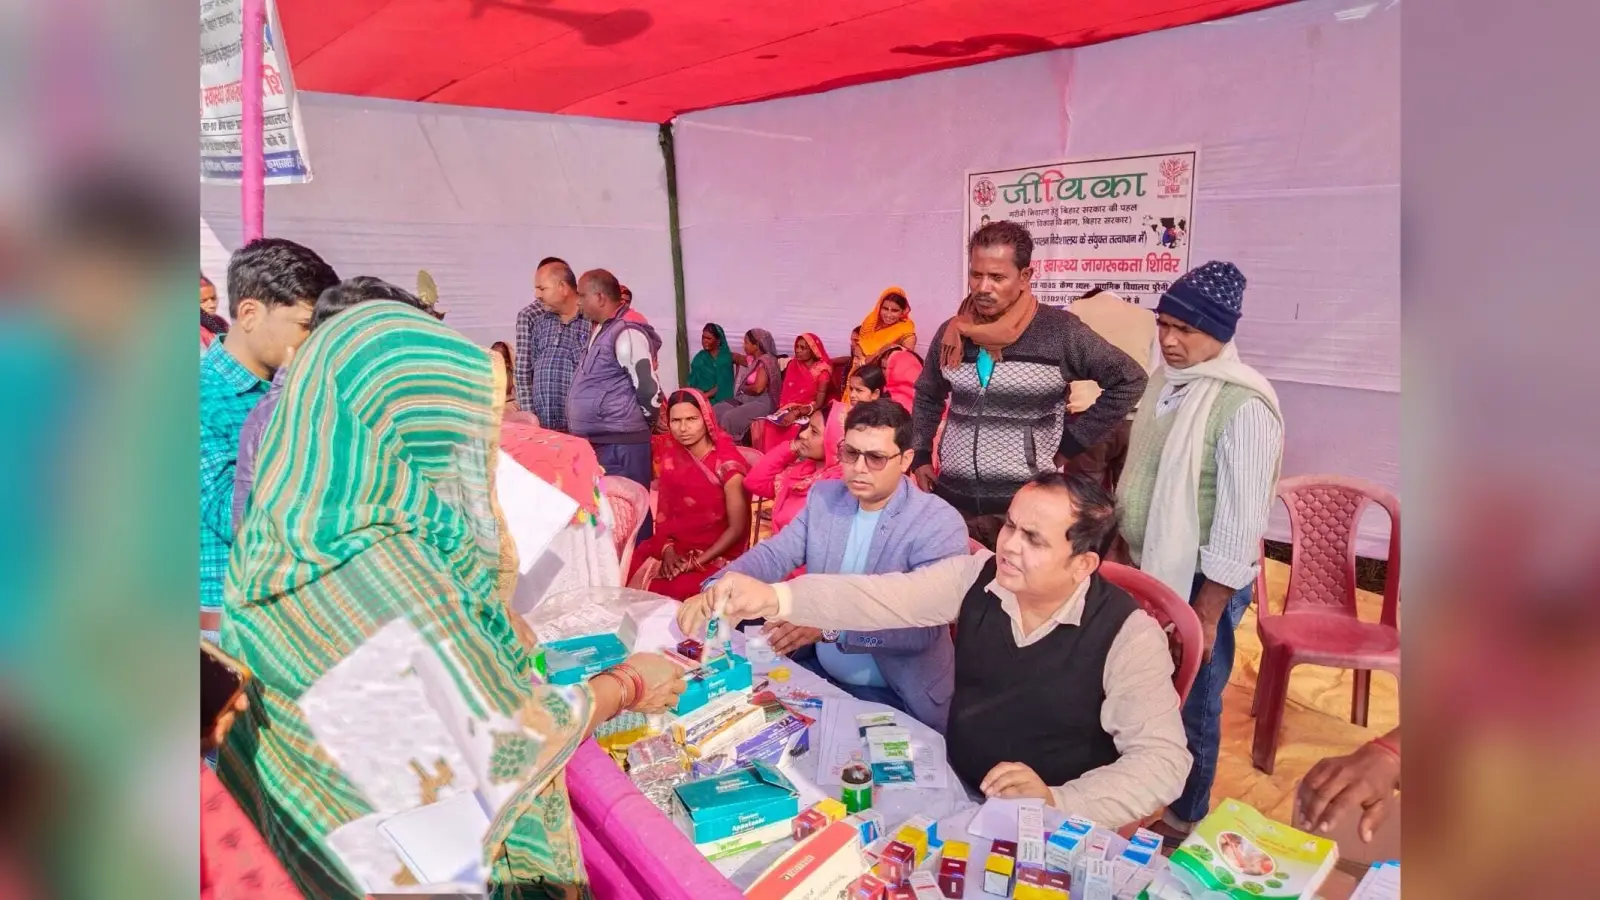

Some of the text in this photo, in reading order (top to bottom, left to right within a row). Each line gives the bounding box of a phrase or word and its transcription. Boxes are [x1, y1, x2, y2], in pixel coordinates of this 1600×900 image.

[998, 169, 1148, 205] जीविका
[1060, 205, 1080, 214] बिहार
[1082, 205, 1106, 213] सरकार
[1108, 203, 1118, 212] की
[1120, 203, 1138, 212] पहल
[1083, 216, 1101, 225] बिहार
[1104, 215, 1132, 224] सरकार)
[1079, 233, 1086, 244] के
[1087, 233, 1107, 249] संयुक्त
[1081, 258, 1143, 273] जागरूकता
[1146, 252, 1181, 273] शिविर
[1123, 281, 1150, 291] विद्यालय
